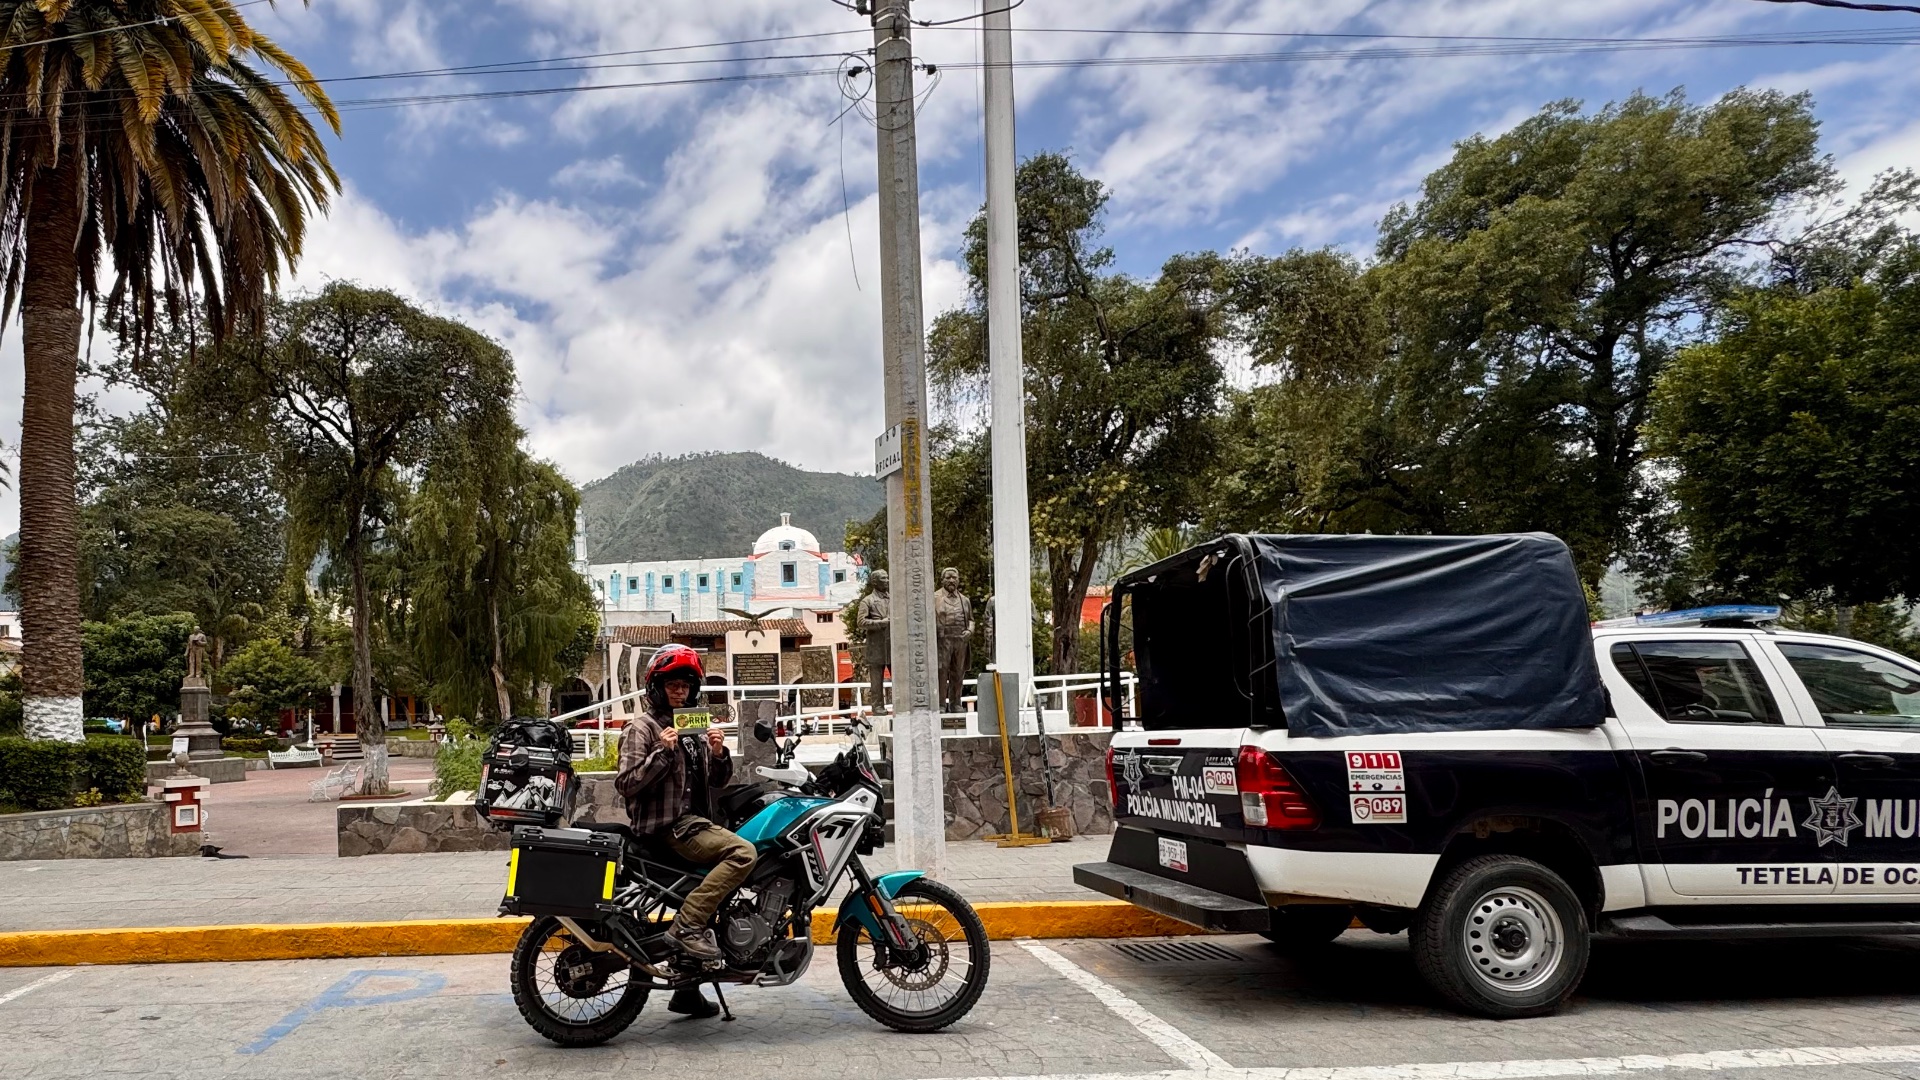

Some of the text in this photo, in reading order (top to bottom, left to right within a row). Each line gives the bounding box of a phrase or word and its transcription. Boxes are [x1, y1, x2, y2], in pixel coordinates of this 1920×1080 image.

[876, 451, 901, 474] OFICIAL
[689, 716, 708, 724] RRM
[1205, 756, 1235, 766] HILUX
[1351, 754, 1396, 768] 911
[1215, 772, 1233, 785] 089
[1171, 775, 1205, 800] PM-04
[1160, 798, 1221, 828] MUNICIPAL
[1372, 799, 1401, 813] 089
[1657, 787, 1920, 839] POLICÍA MU
[1736, 867, 1920, 885] TETELA DE OC
